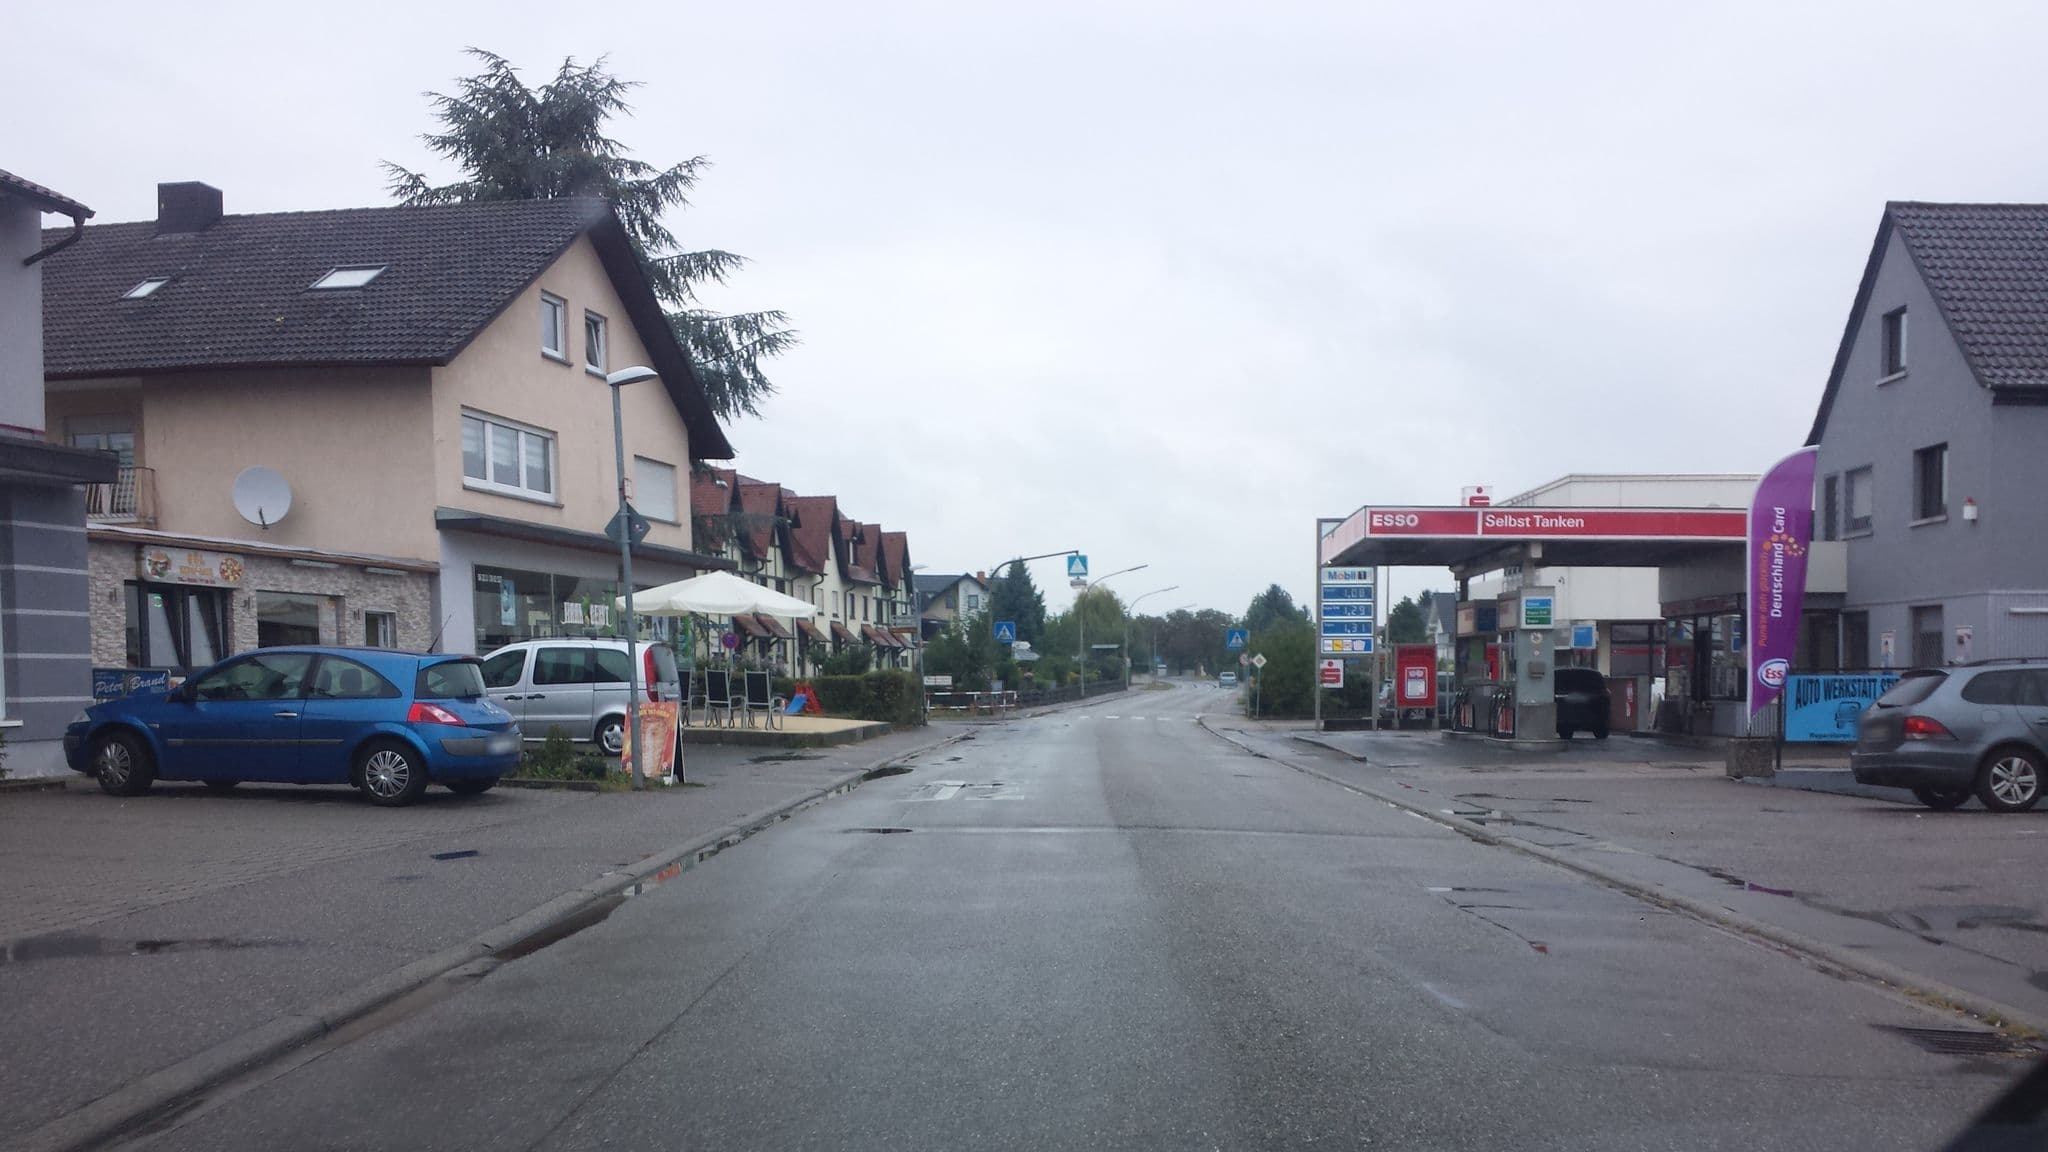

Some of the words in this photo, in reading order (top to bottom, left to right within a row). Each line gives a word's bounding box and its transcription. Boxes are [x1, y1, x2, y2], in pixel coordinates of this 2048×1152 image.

[1372, 514, 1419, 527] ESSO
[1485, 515, 1531, 527] Selbst
[1533, 515, 1585, 528] Tanken
[1772, 507, 1786, 534] Card
[1328, 571, 1357, 580] Mobil
[1771, 543, 1785, 618] Deutschland
[129, 673, 166, 690] Brand
[1795, 678, 1820, 711] AUTO
[1823, 678, 1877, 702] WERKSTATT
